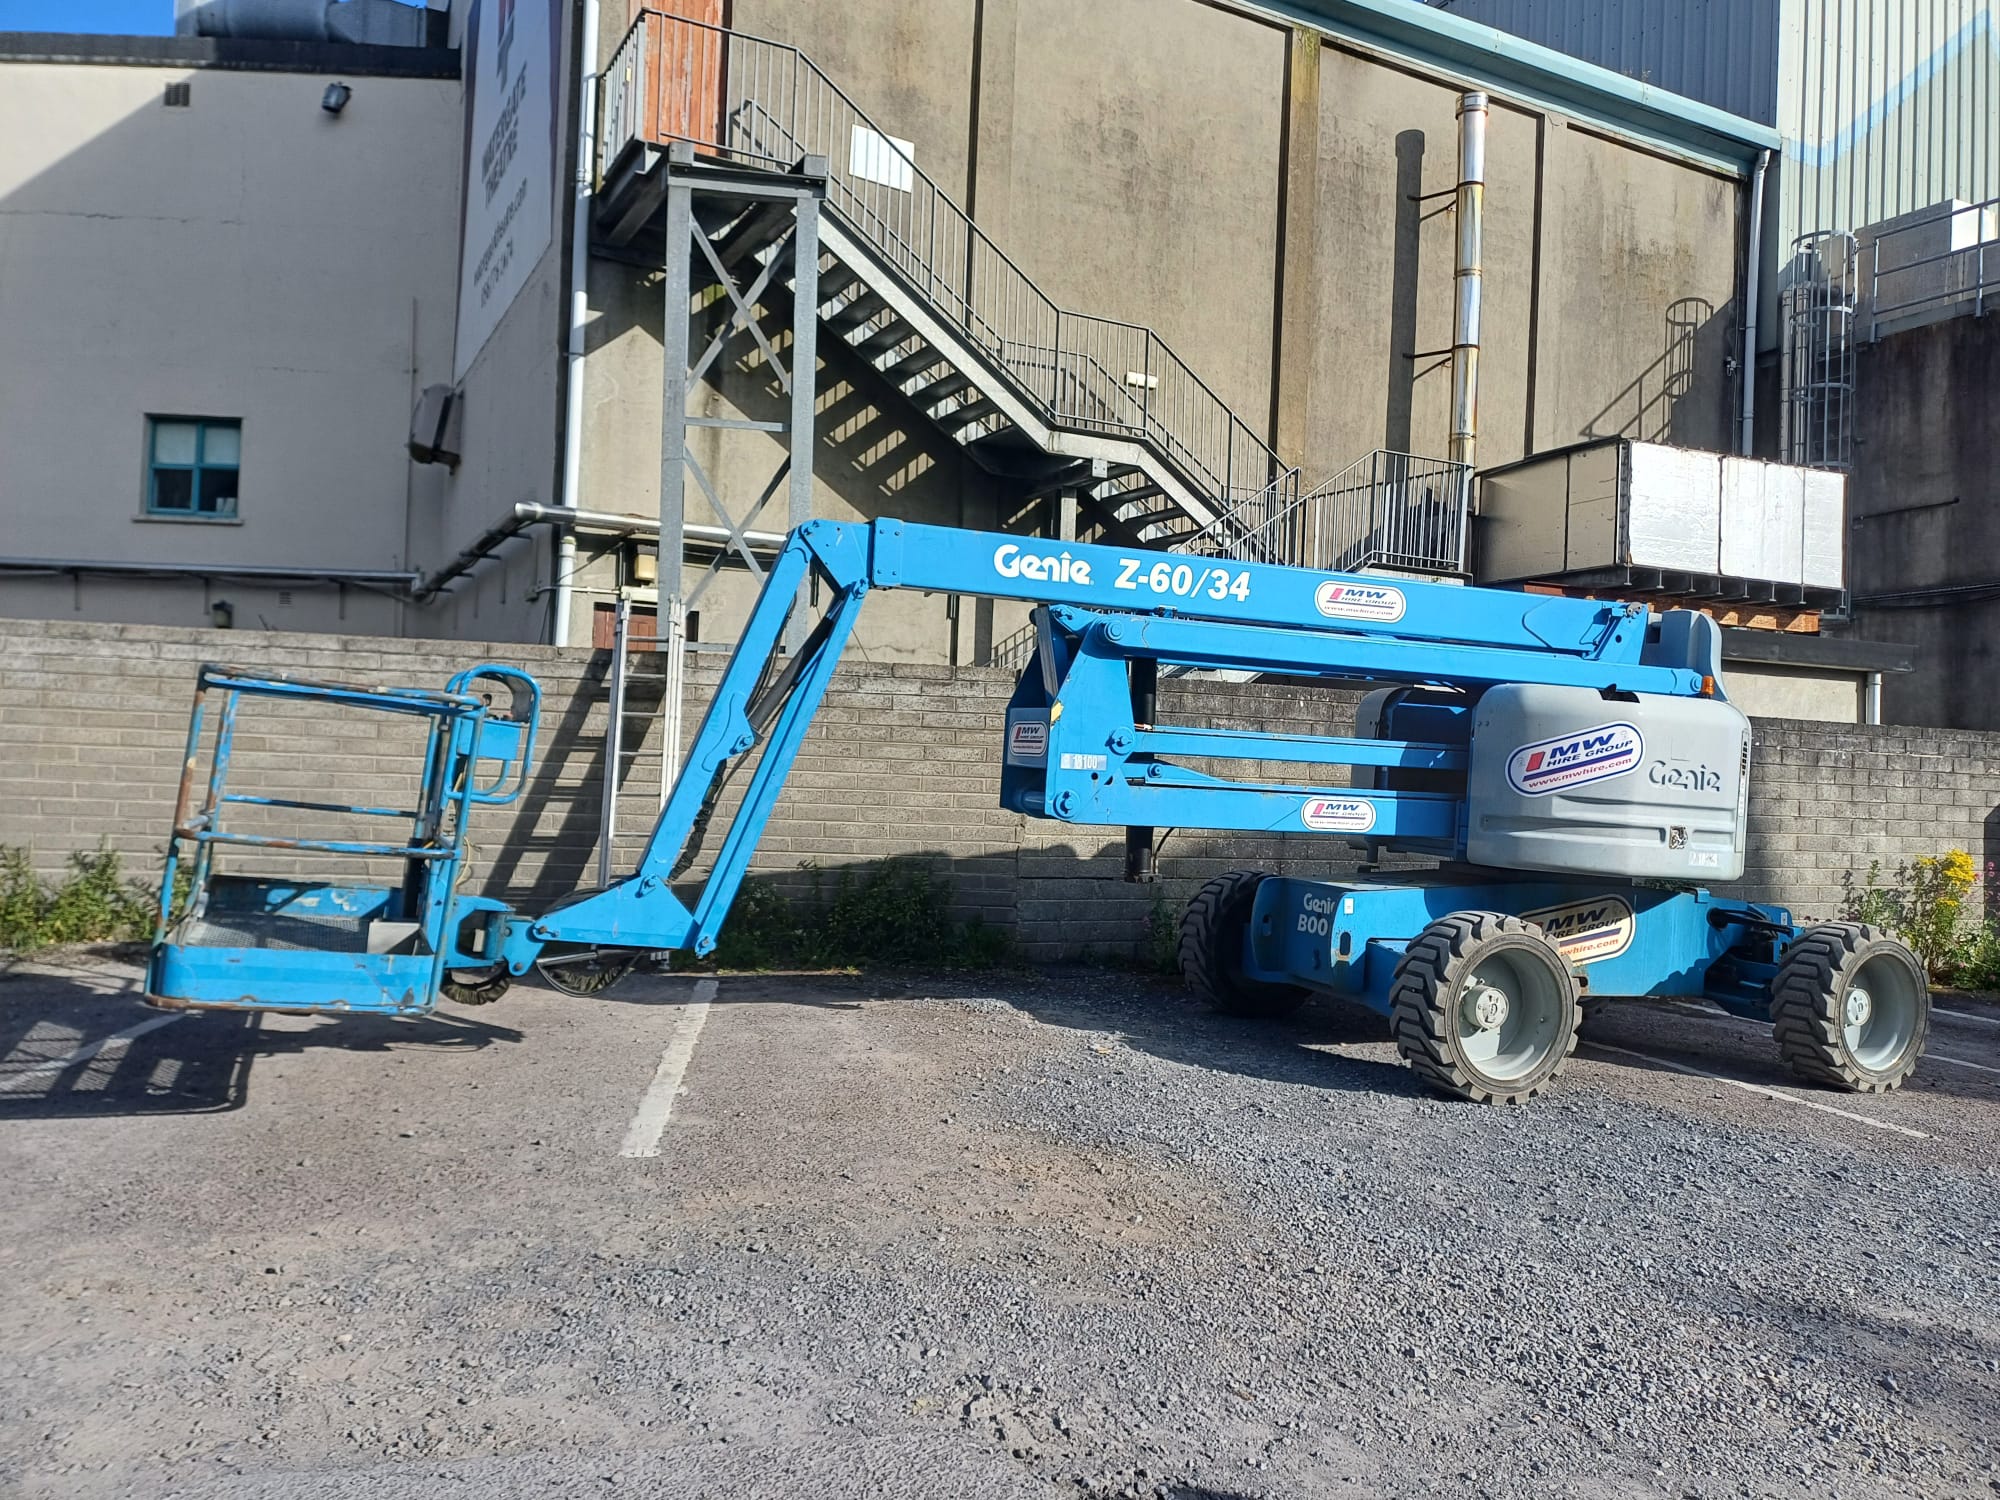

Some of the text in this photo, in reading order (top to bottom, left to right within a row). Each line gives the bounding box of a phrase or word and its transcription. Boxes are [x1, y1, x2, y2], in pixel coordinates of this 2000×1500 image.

[994, 544, 1251, 602] Genie Z-60/34
[1345, 589, 1388, 599] MW
[1021, 726, 1040, 735] MW
[1547, 740, 1633, 767] HIRE GROUP
[1550, 733, 1616, 759] MW
[1529, 758, 1632, 788] www.mwhire.com
[1649, 760, 1720, 792] Genie
[1325, 803, 1360, 811] MW
[1546, 907, 1608, 932] MW
[1578, 917, 1623, 933] GROUP
